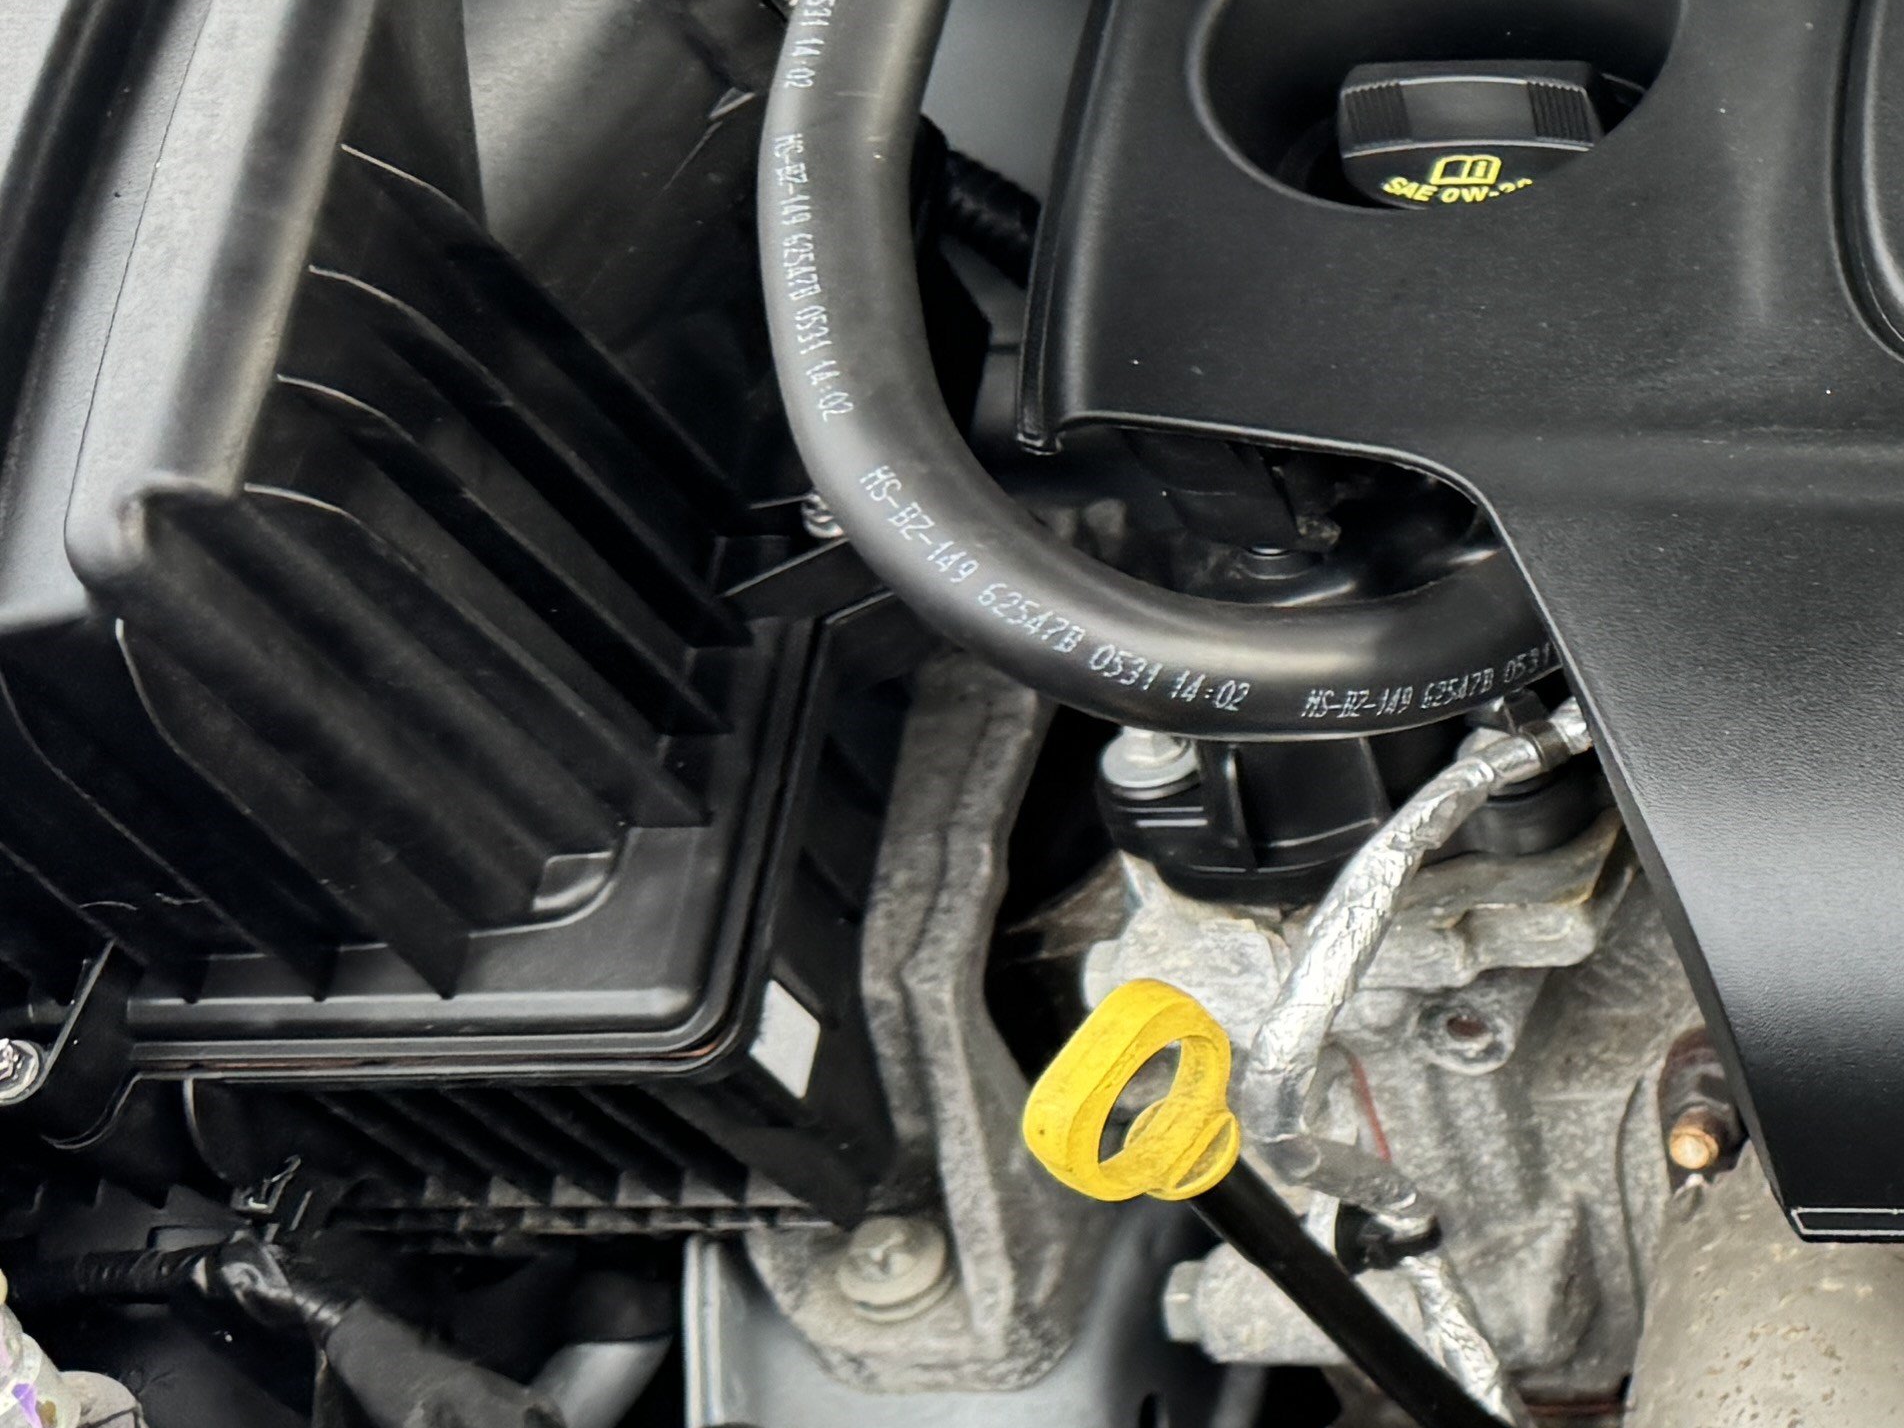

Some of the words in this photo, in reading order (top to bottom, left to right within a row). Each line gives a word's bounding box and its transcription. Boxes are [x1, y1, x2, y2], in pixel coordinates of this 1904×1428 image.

[1382, 176, 1438, 202] SAE
[1088, 644, 1164, 691] 0531
[1170, 669, 1252, 712] 14:02
